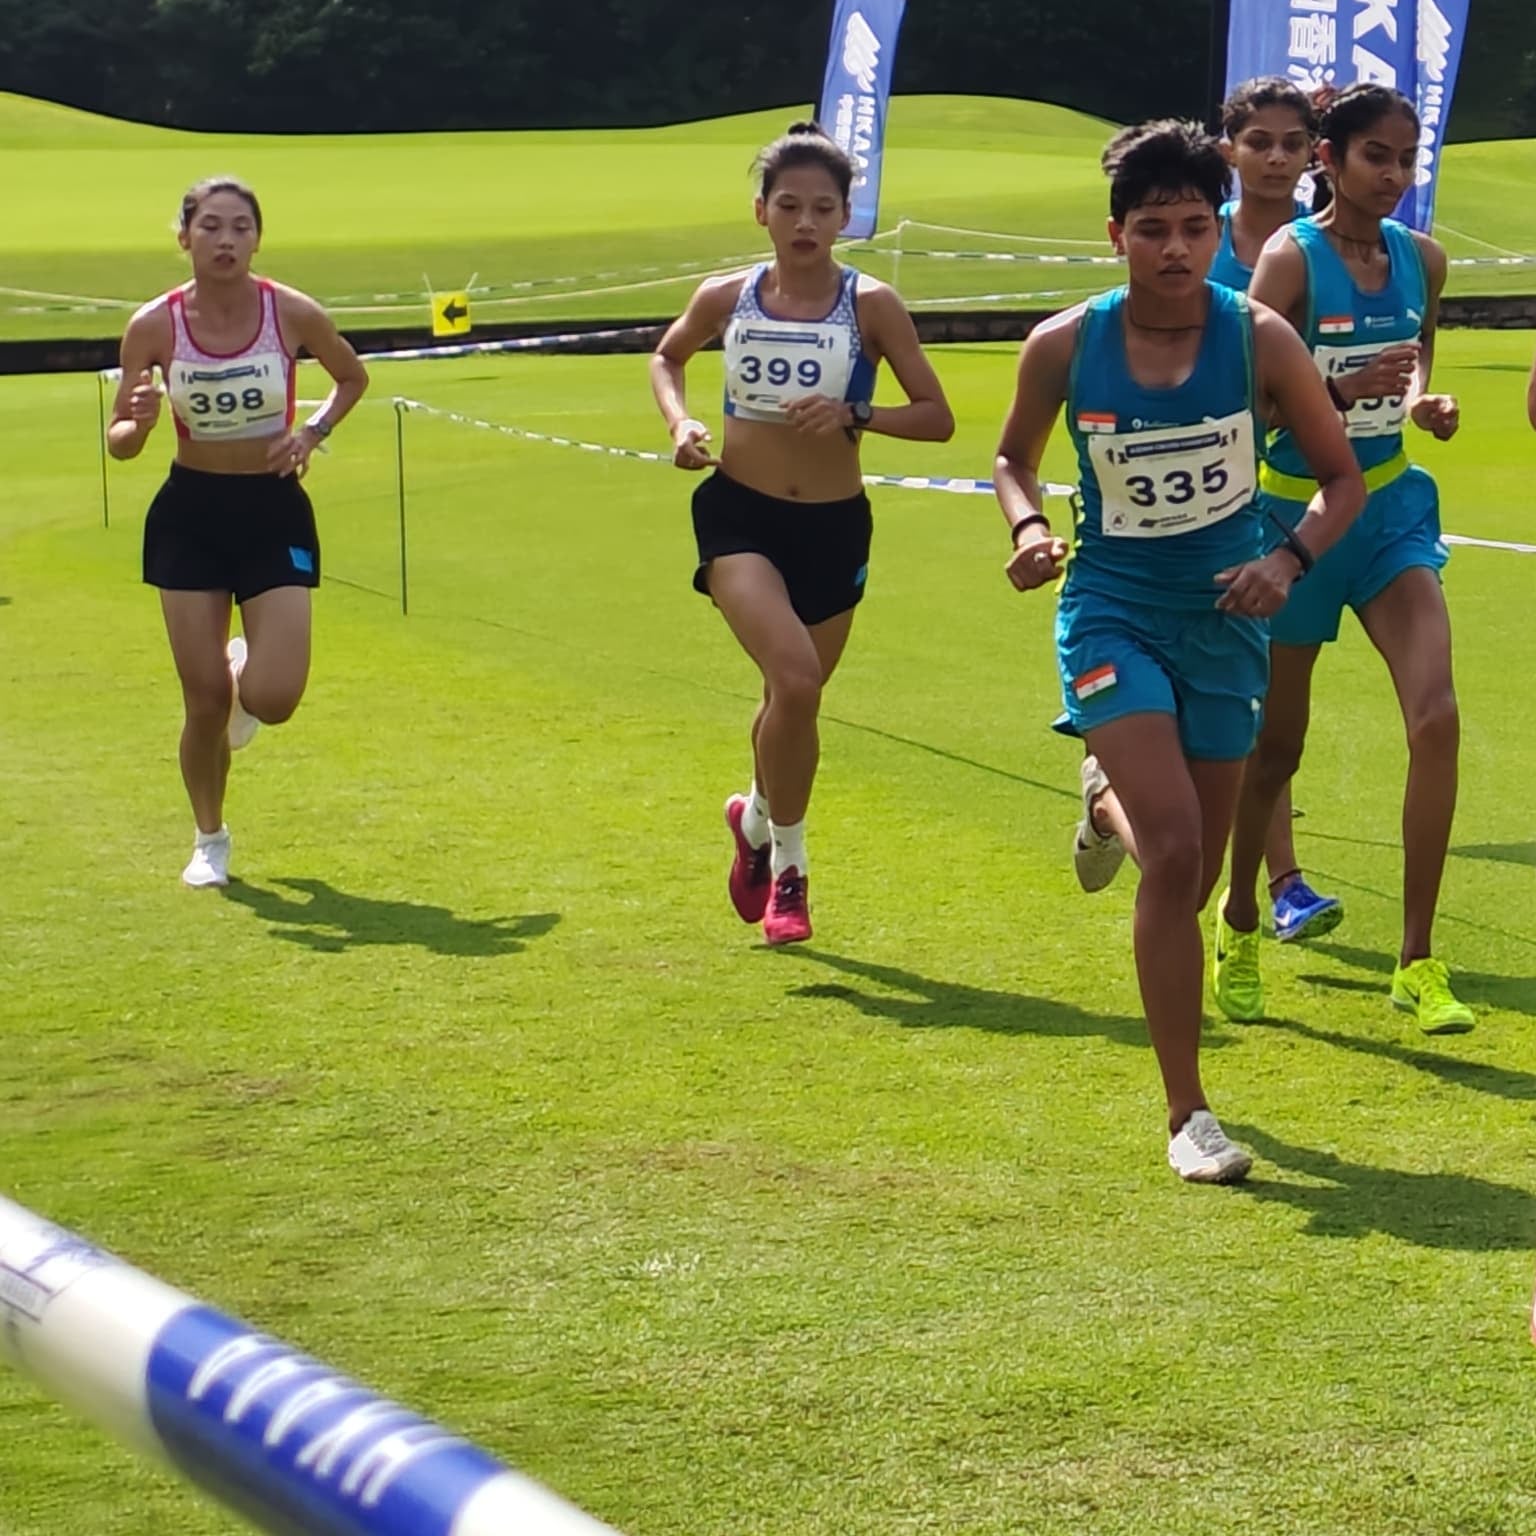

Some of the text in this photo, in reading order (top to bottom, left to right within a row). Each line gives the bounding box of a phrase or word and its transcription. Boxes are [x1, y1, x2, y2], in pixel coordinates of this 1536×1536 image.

[739, 355, 822, 388] 399
[189, 388, 265, 415] 398
[1125, 458, 1229, 507] 335
